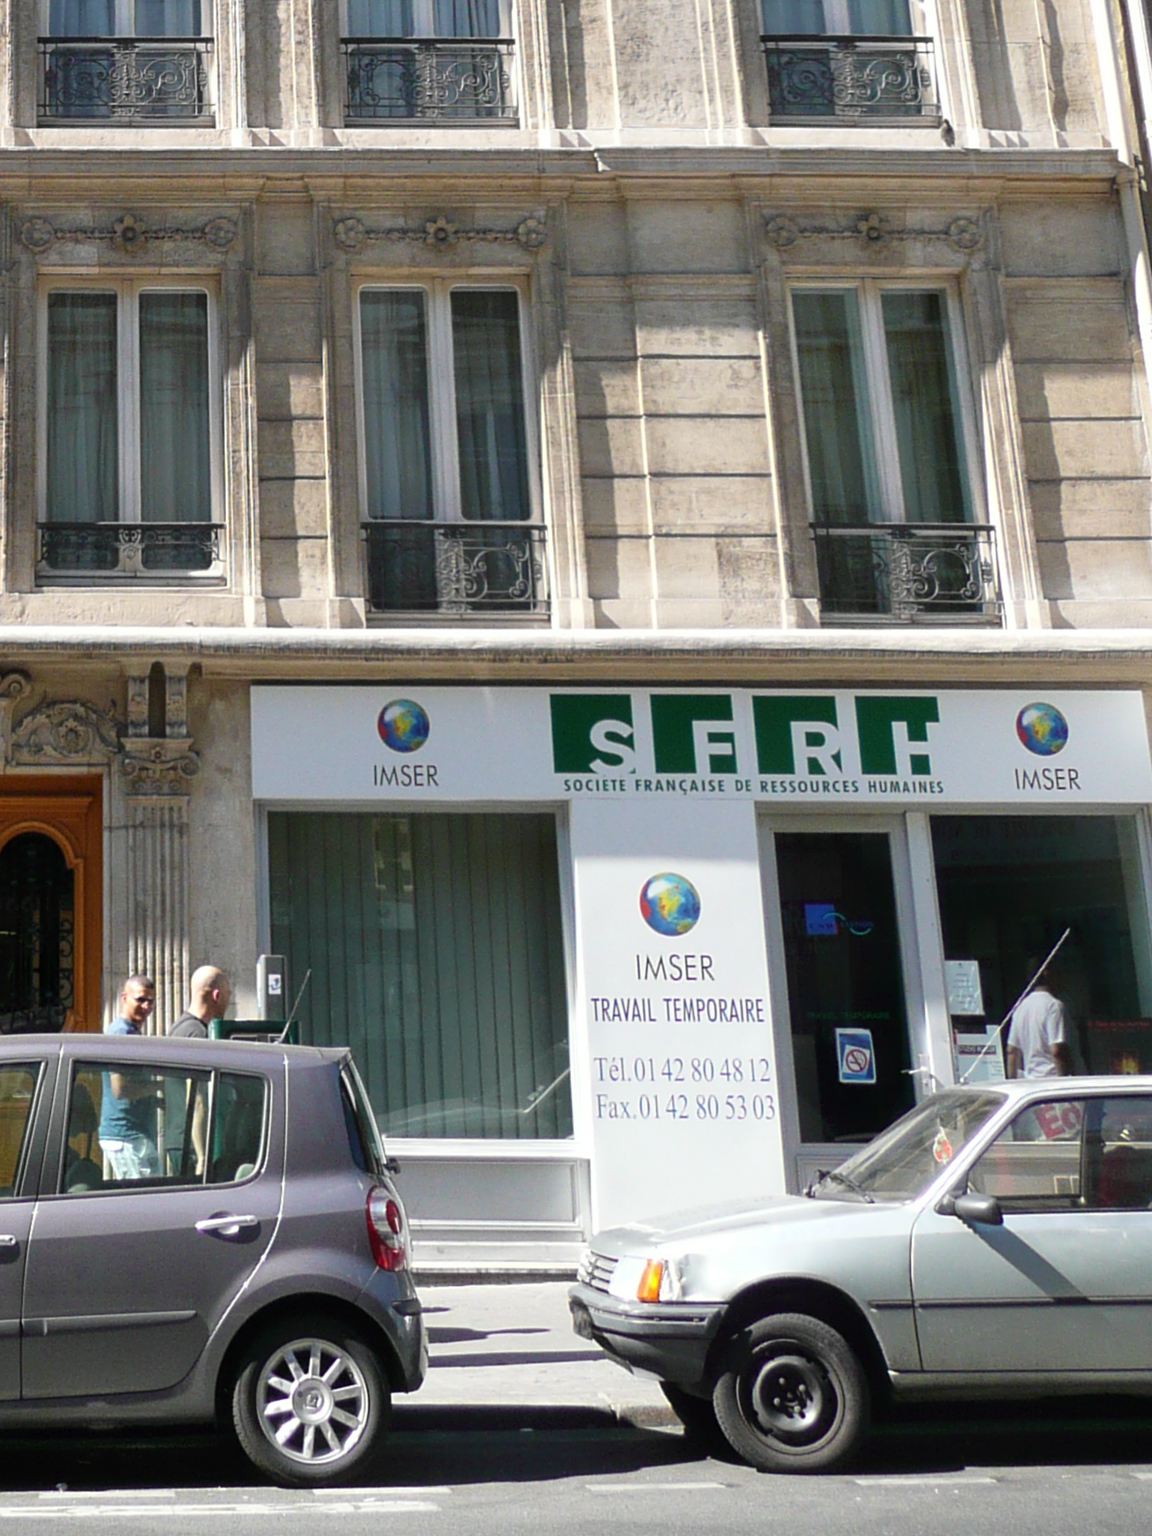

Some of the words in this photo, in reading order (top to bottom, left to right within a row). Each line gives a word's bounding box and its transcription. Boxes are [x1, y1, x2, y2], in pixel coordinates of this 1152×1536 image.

[373, 764, 440, 787] IMSER
[635, 779, 725, 795] FRANÇAISE
[735, 779, 752, 792] DE
[760, 779, 860, 793] RESSOURCES
[868, 780, 944, 794] HUMAINES
[1015, 768, 1081, 790] IMSER
[635, 954, 715, 981] IMSER
[591, 998, 657, 1022] TRAVAIL
[663, 998, 765, 1023] TEMPORAIRE
[661, 1057, 685, 1082] 42
[691, 1057, 714, 1082] 80
[720, 1057, 744, 1082] 48
[750, 1057, 771, 1082] 12
[665, 1094, 689, 1120] 42
[696, 1094, 719, 1120] 80
[725, 1094, 748, 1120] 53
[752, 1094, 776, 1120] 03
